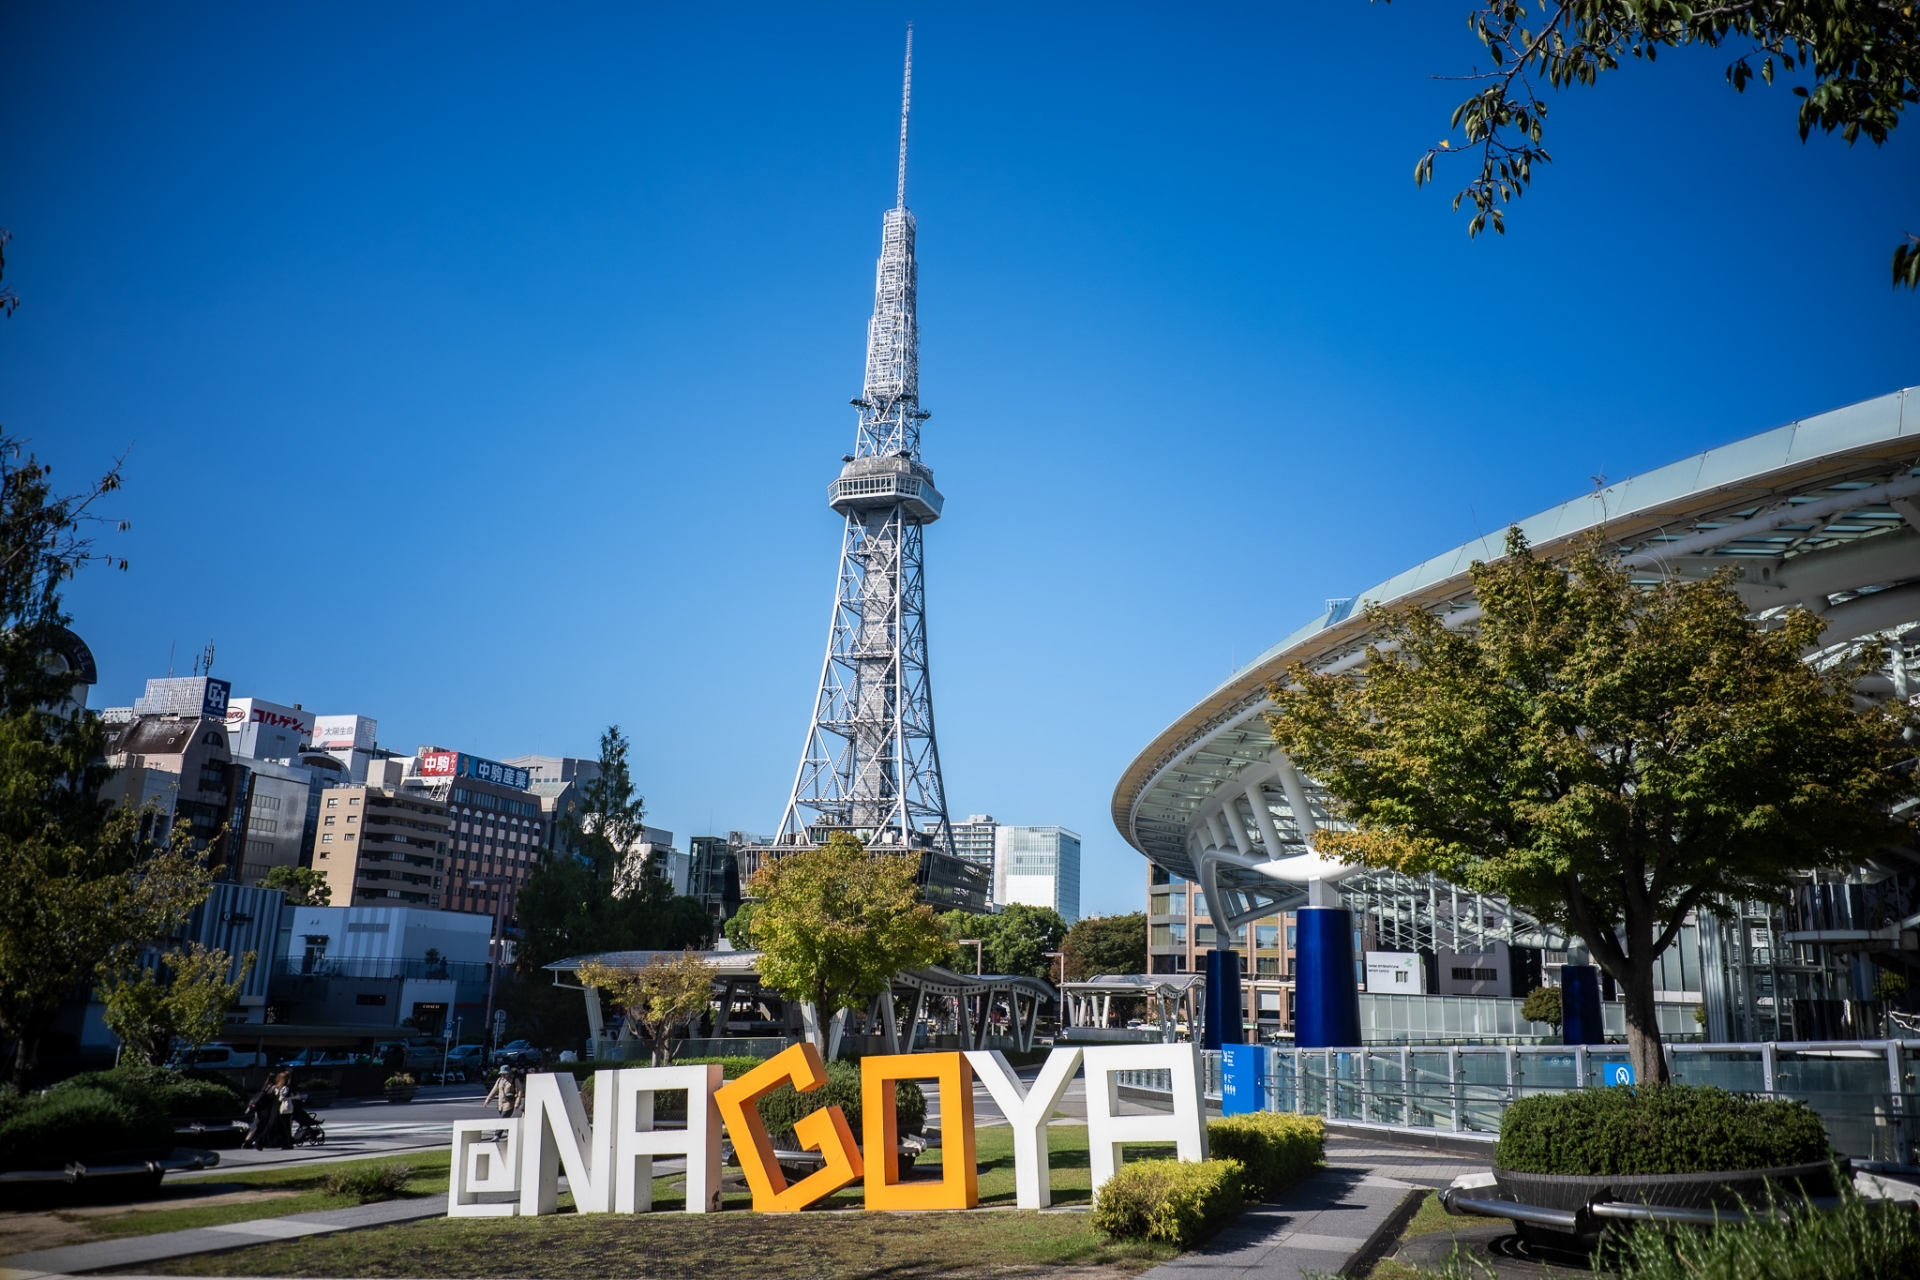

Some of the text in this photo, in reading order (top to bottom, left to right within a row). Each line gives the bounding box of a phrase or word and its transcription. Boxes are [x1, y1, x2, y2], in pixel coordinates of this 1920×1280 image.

[324, 726, 354, 736] 太陽生命
[424, 755, 450, 773] 中駒
[449, 754, 457, 773] グループ
[478, 761, 528, 788] 中駒産業
[446, 1022, 452, 1030] P
[447, 1043, 1210, 1217] @NAGOYA
